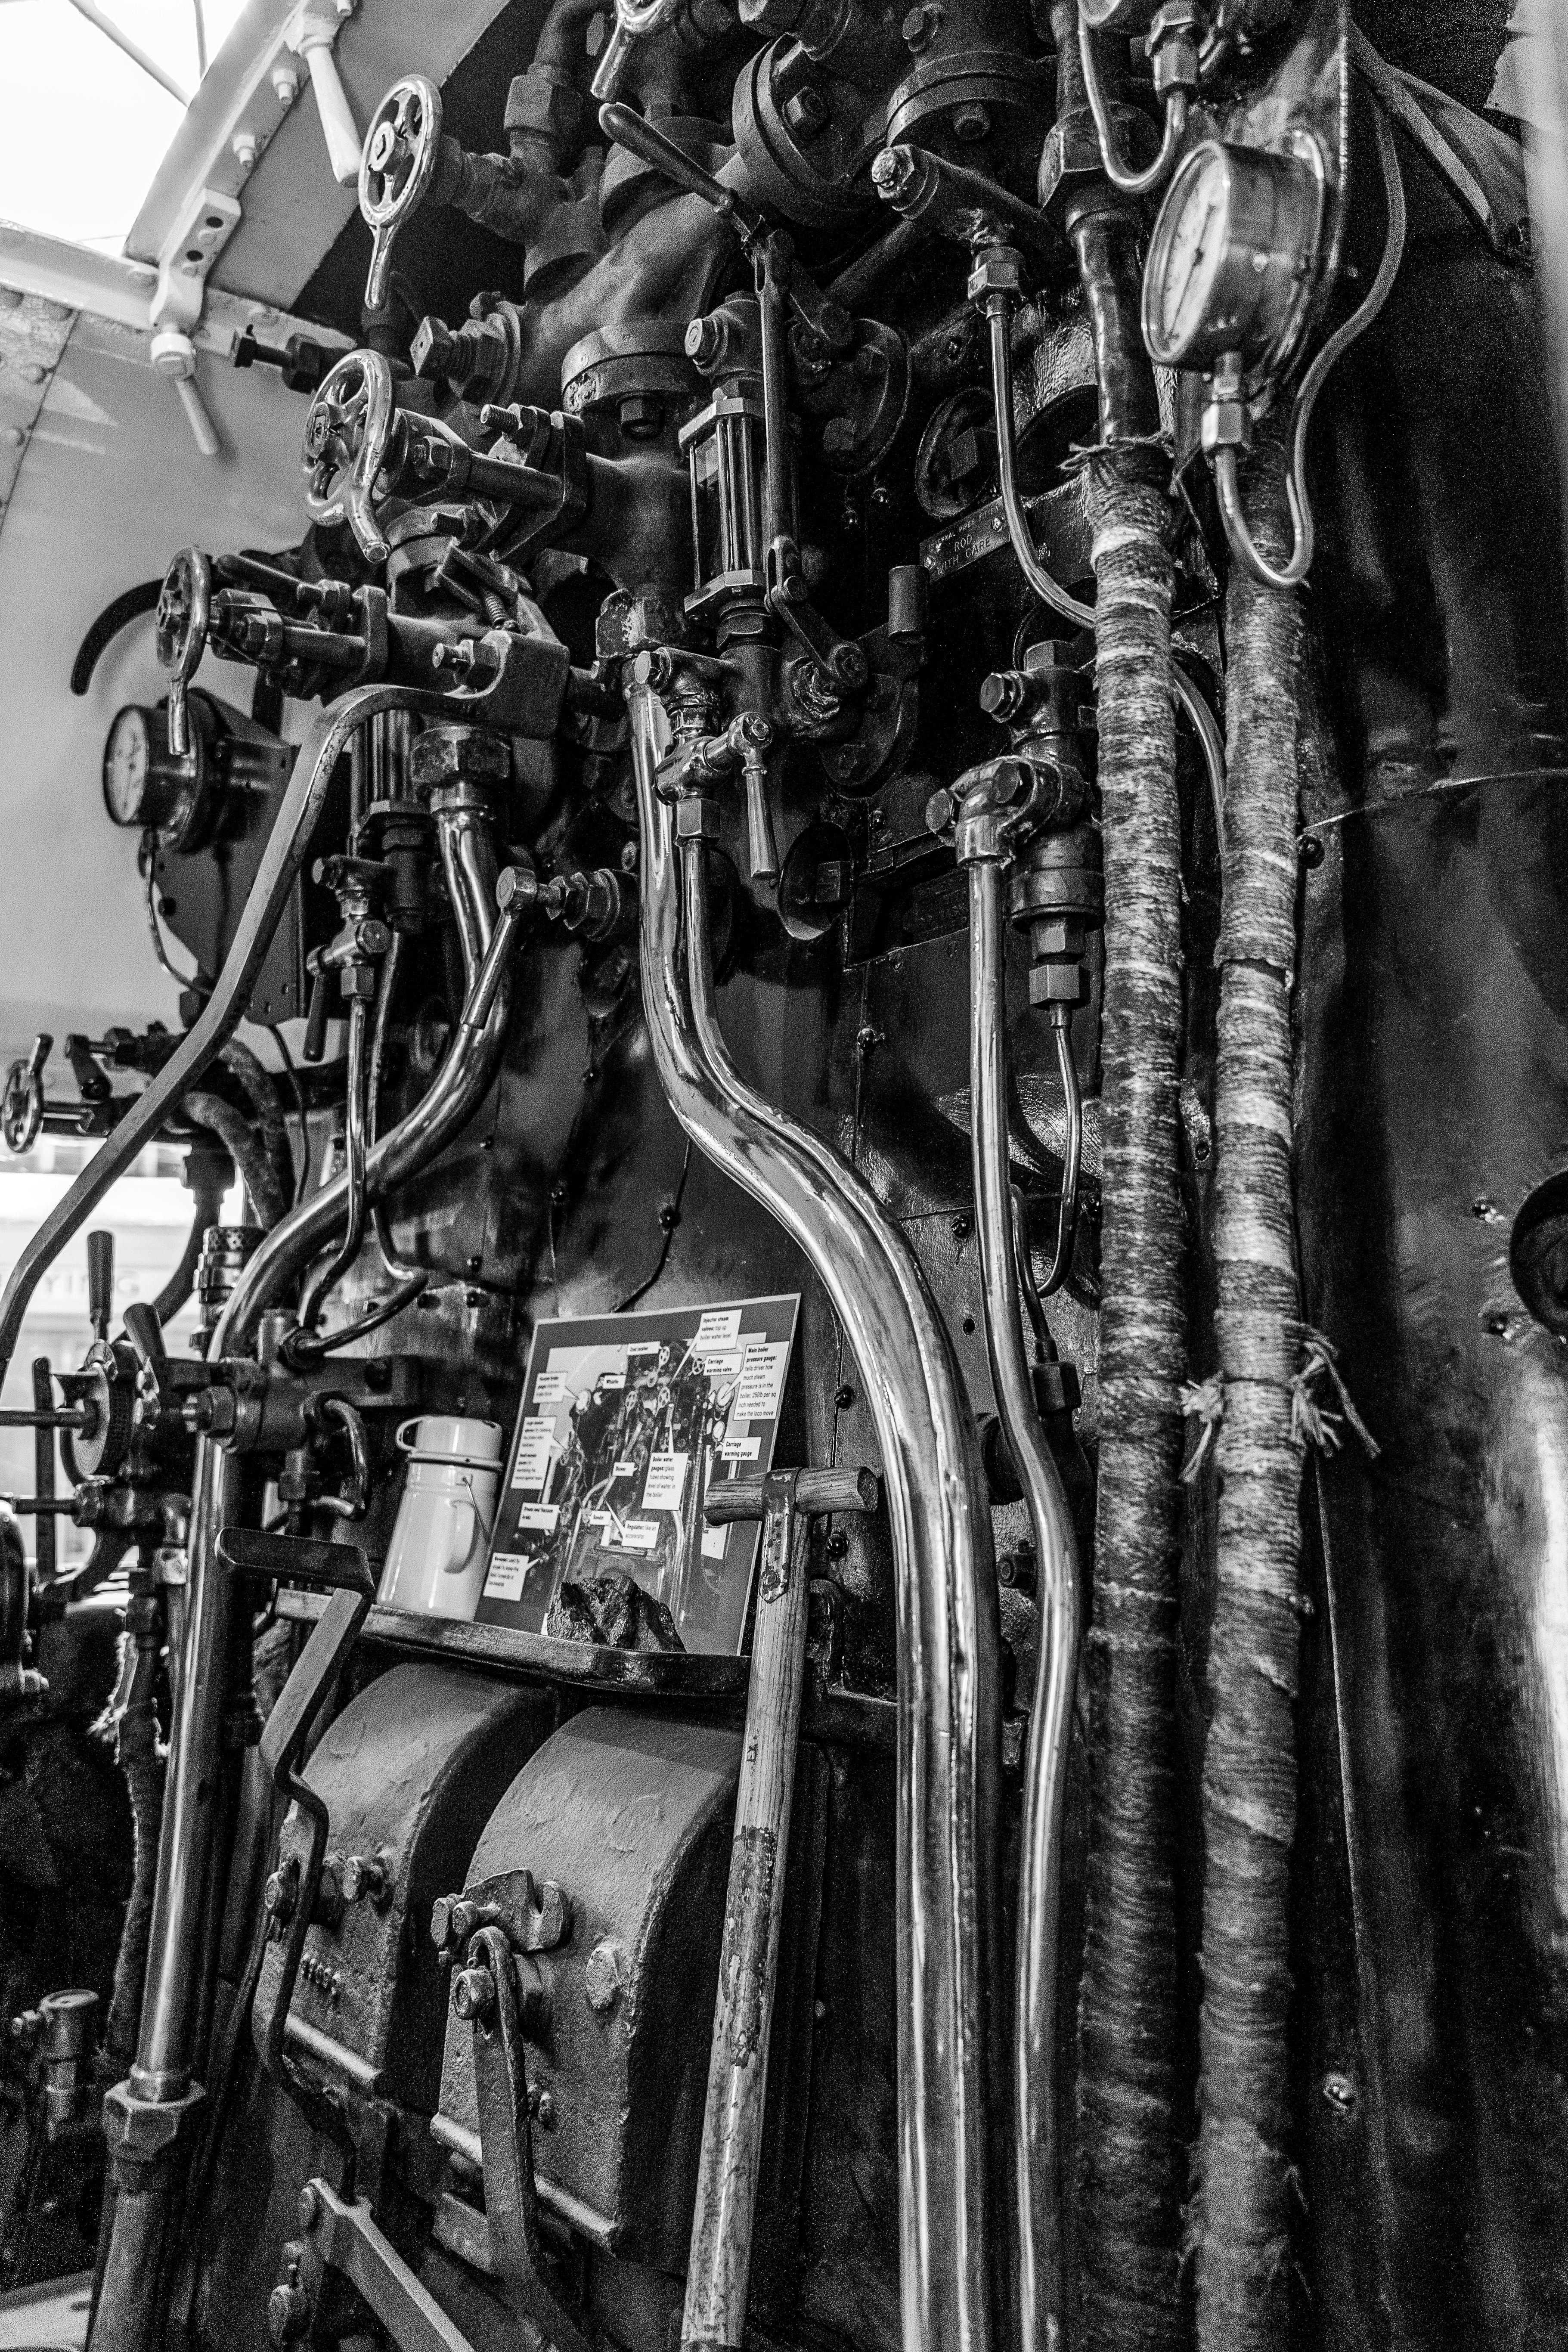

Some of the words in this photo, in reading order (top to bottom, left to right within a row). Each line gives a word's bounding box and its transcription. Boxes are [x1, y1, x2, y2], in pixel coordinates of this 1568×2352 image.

[936, 555, 959, 576] WITH
[965, 536, 991, 558] CARE
[954, 534, 972, 552] ROD
